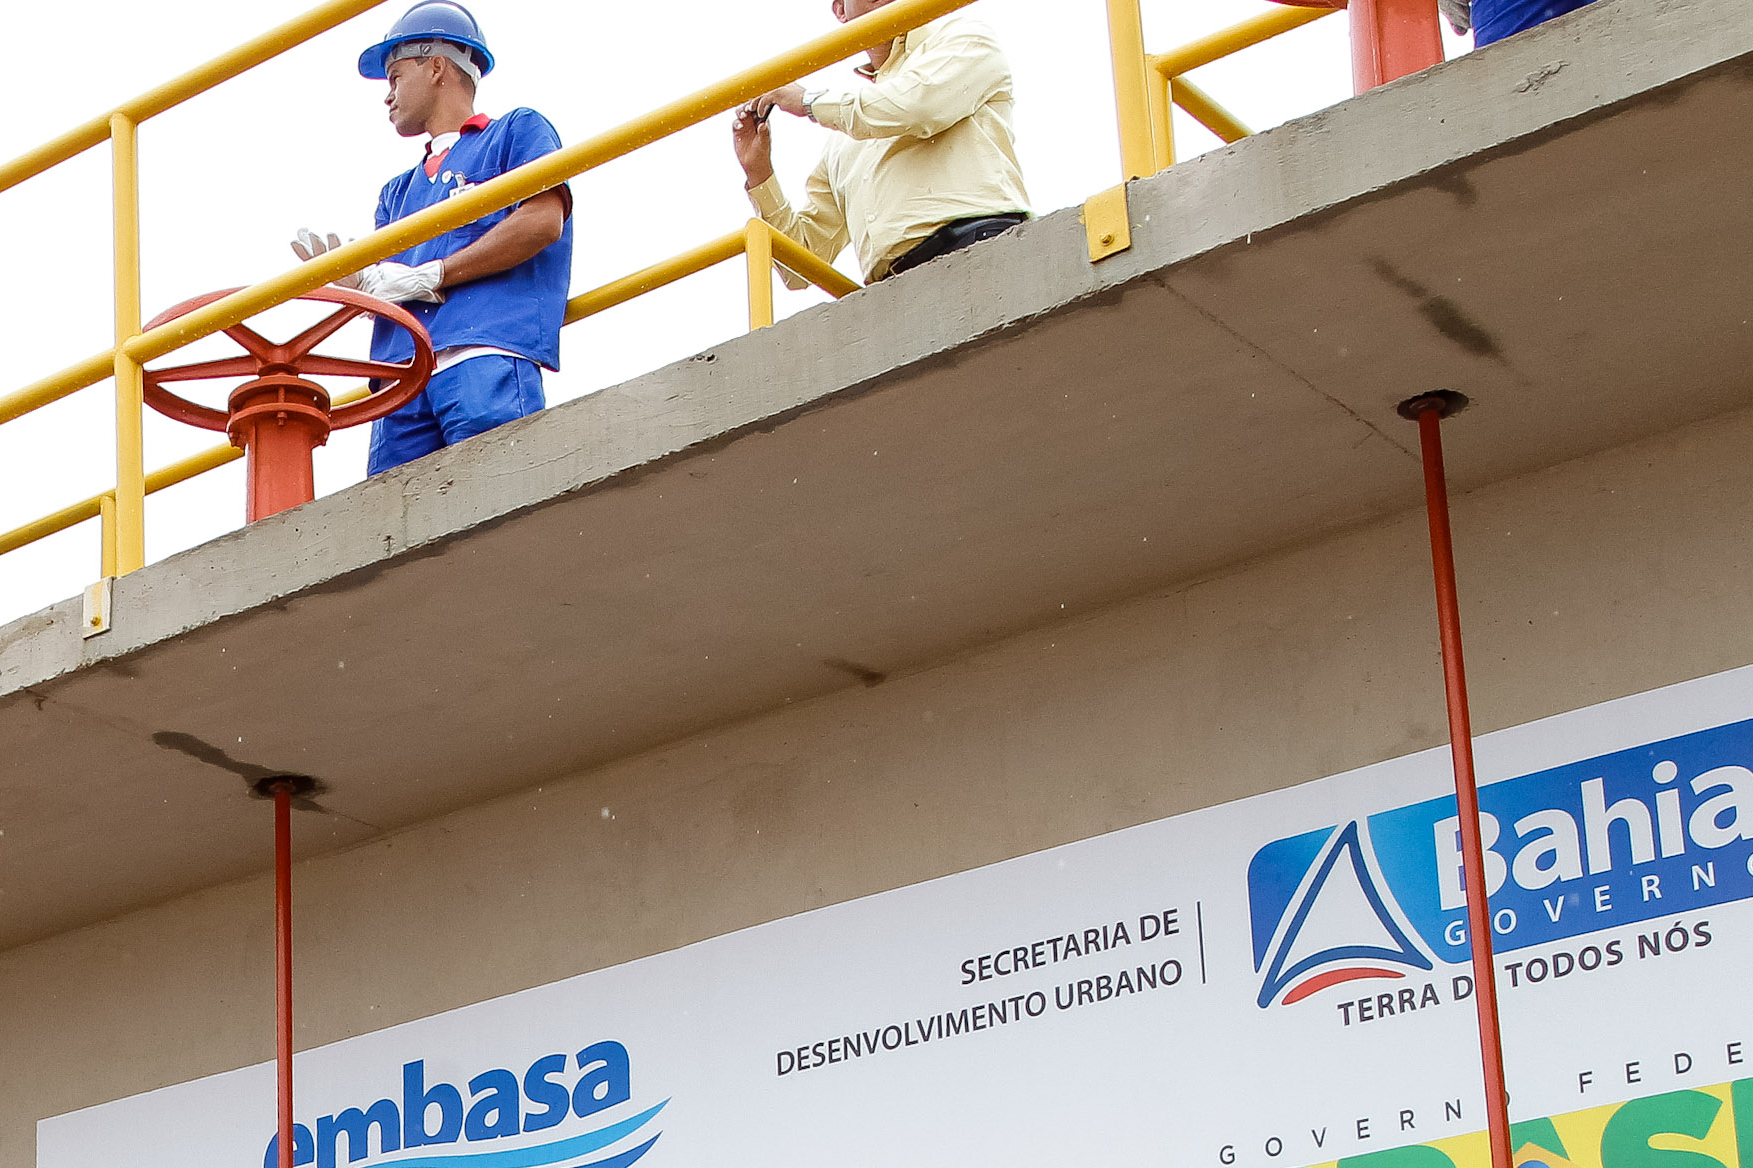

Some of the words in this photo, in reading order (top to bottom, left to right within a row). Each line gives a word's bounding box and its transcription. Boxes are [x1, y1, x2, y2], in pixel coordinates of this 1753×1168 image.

[1433, 759, 1753, 912] Bahia
[960, 922, 1132, 985] SECRETARIA
[1139, 908, 1180, 942] DE
[1444, 852, 1753, 947] GOVERN
[777, 991, 1047, 1077] DESENVOLVIMENTO
[1055, 959, 1183, 1010] URBANO
[1337, 983, 1440, 1027] TERRA
[1504, 940, 1624, 988] TODOS
[1638, 919, 1713, 960] NÓS
[1219, 1091, 1511, 1166] GOVERN
[1578, 1042, 1744, 1094] FEDE
